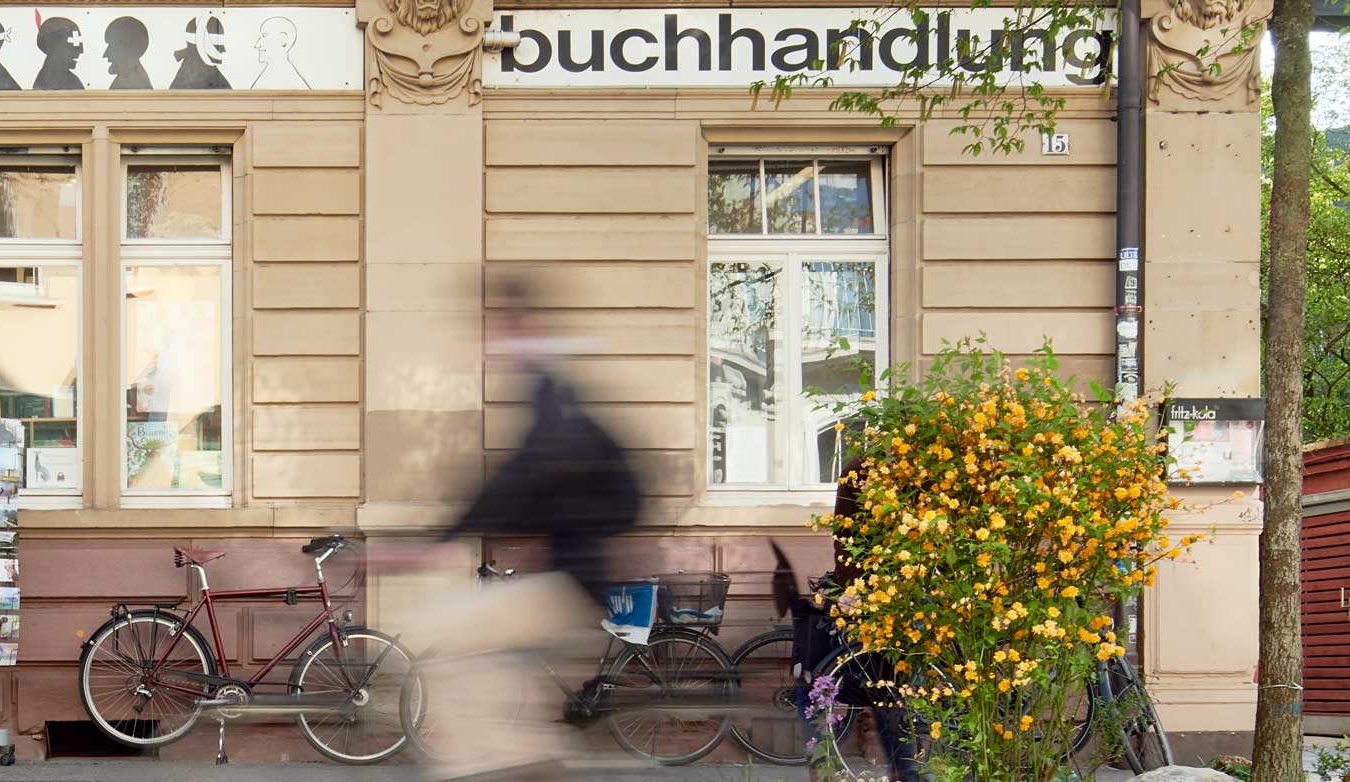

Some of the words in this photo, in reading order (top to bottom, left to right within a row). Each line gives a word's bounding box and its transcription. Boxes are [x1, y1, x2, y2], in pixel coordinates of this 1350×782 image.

[501, 12, 1114, 86] buchhandlung
[1047, 135, 1066, 152] 15
[1170, 404, 1216, 420] fritz-kola
